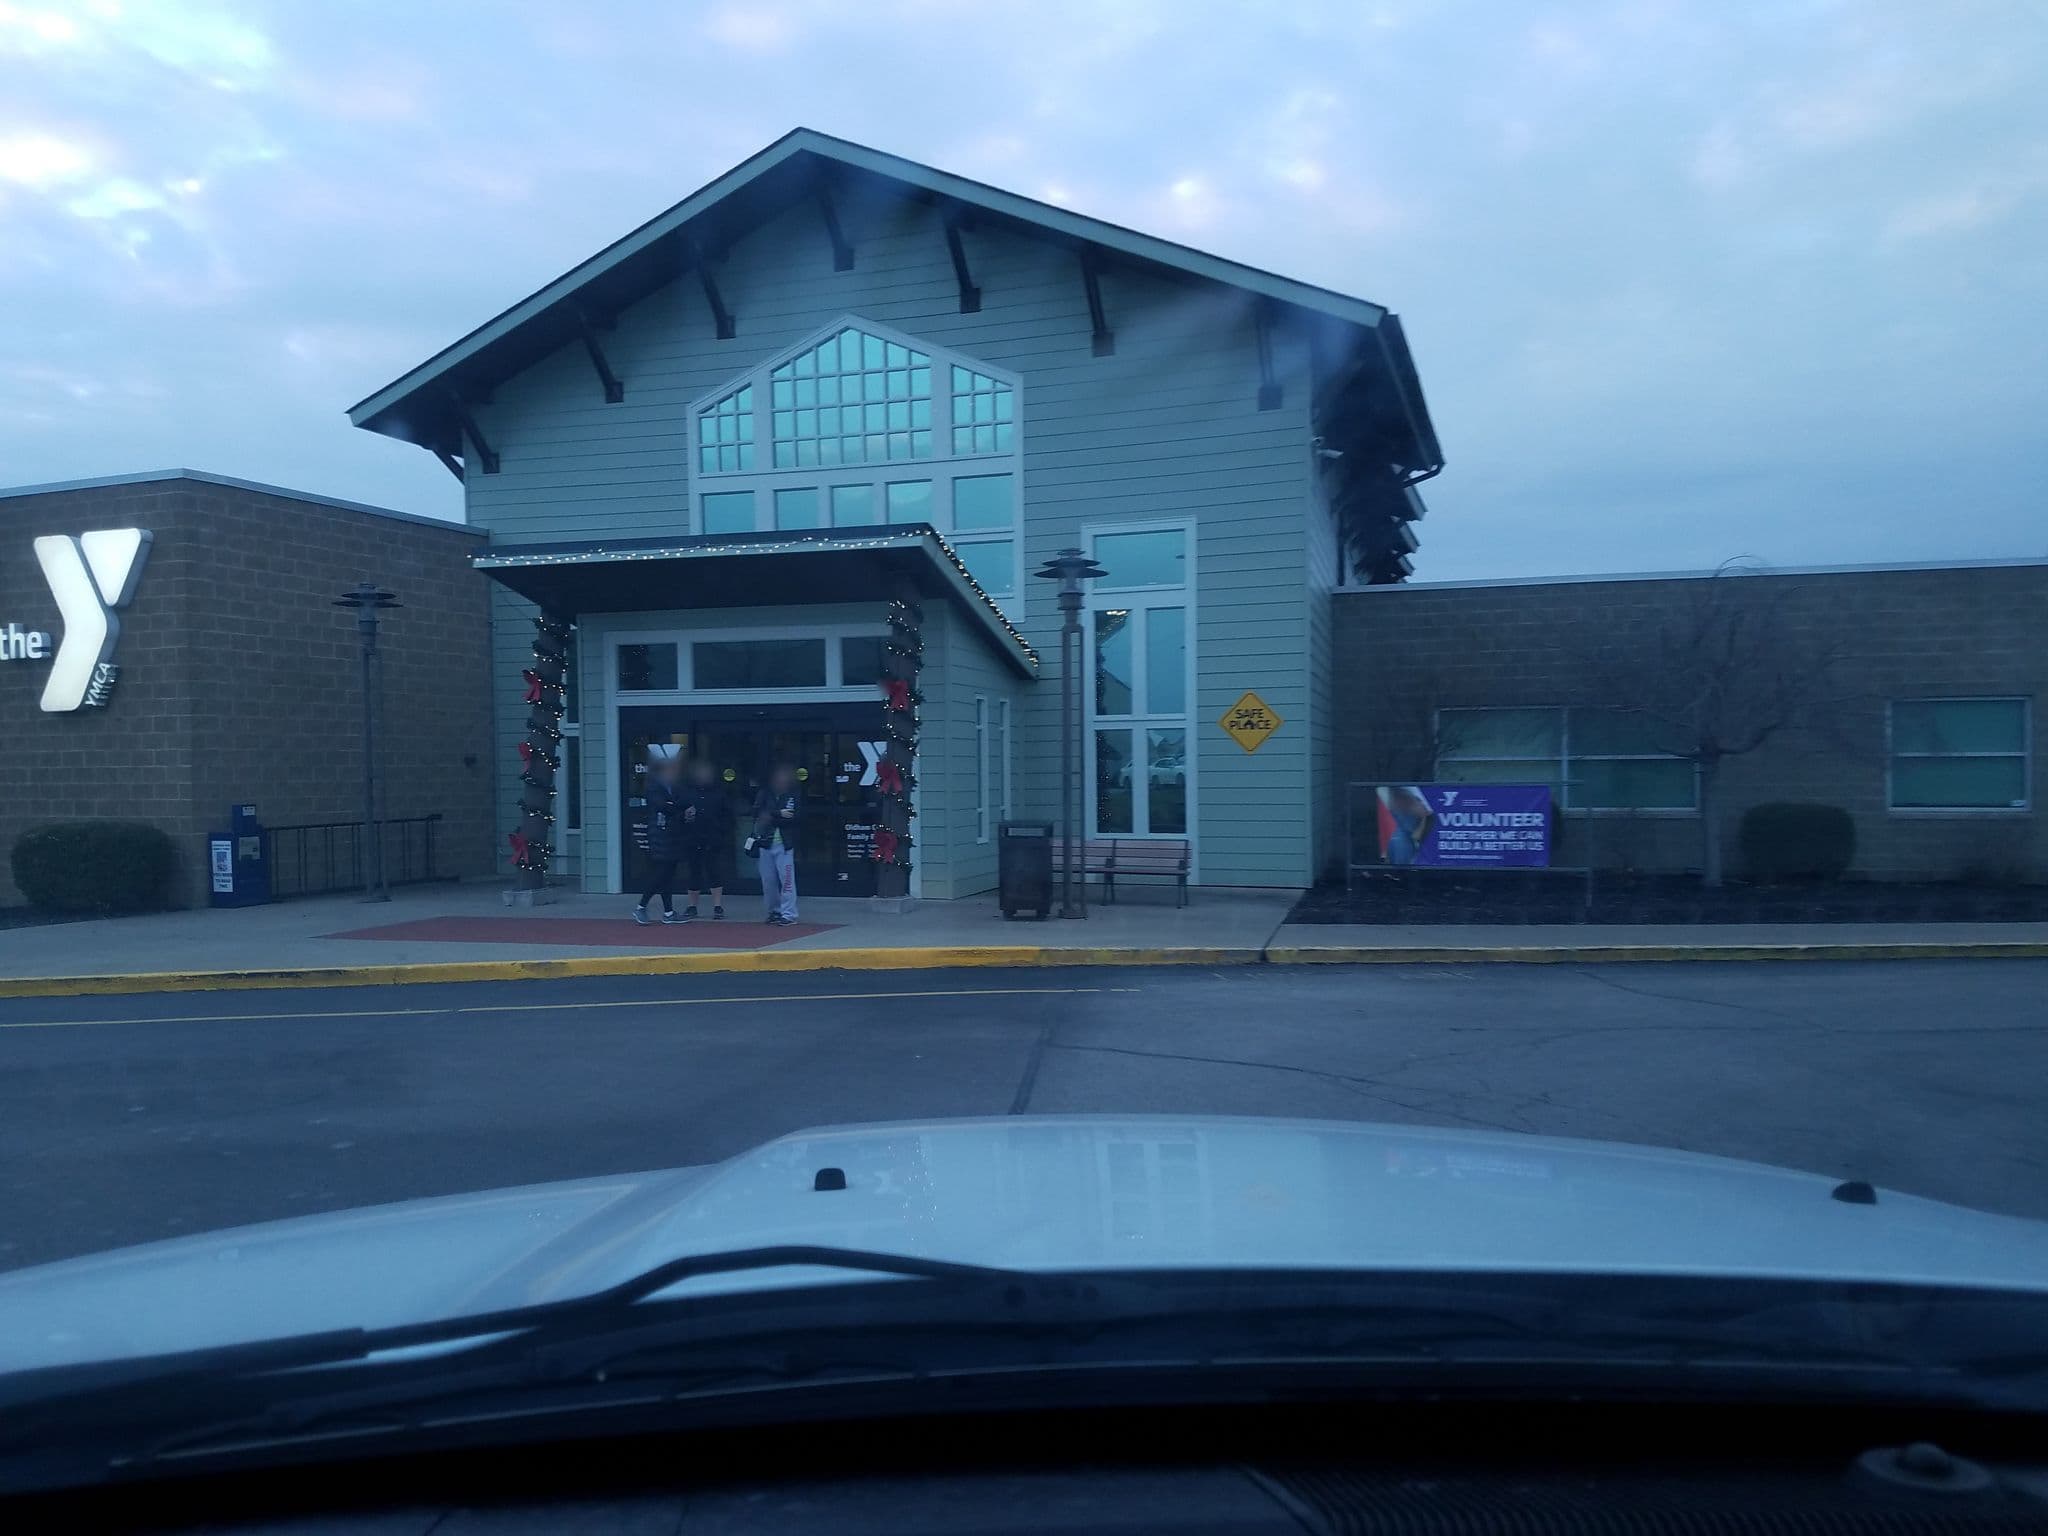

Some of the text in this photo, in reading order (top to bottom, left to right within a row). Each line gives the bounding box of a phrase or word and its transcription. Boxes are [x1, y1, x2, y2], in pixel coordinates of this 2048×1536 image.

[0, 527, 142, 712] the Y
[84, 663, 112, 707] YMCA
[1235, 708, 1264, 719] SAFE
[1229, 719, 1272, 730] PLACE
[843, 762, 861, 772] the
[1437, 812, 1544, 827] VOLUNTEER
[1438, 841, 1472, 851] BUILD
